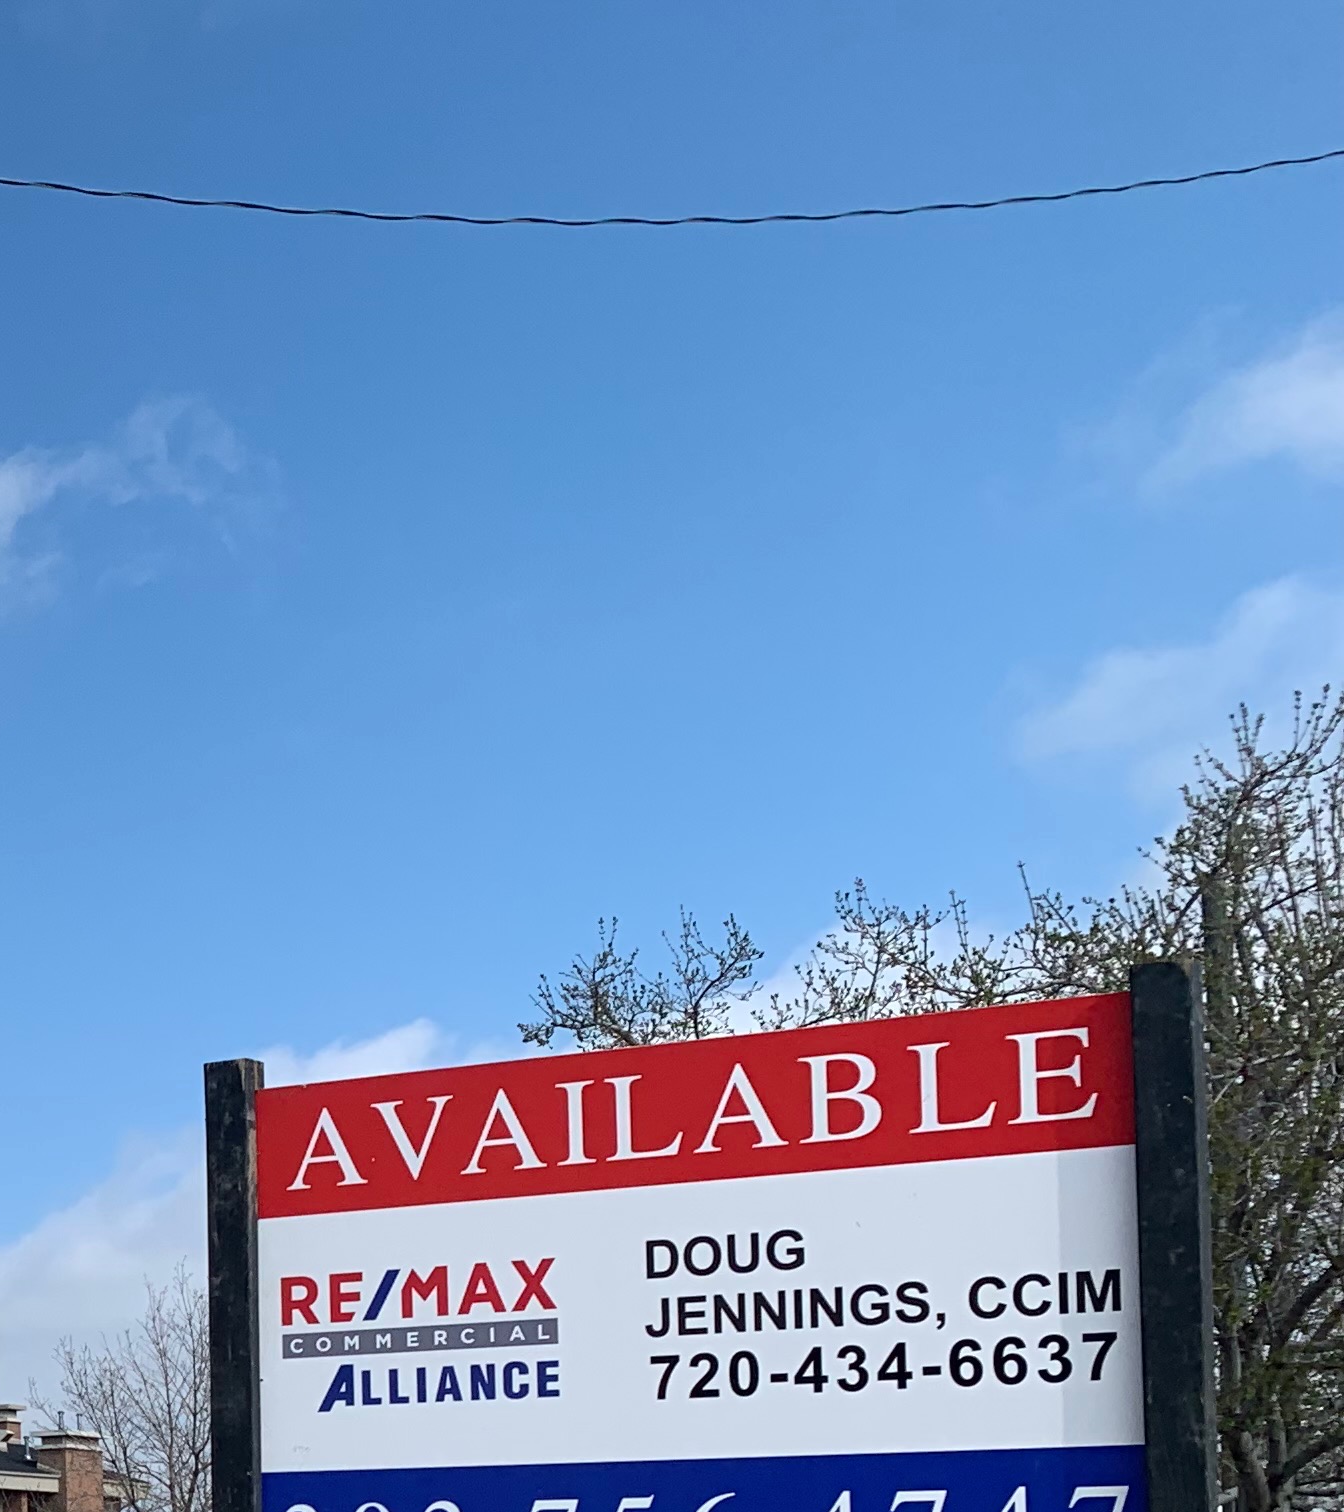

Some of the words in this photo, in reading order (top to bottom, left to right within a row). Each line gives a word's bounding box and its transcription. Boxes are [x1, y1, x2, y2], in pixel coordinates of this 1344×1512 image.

[285, 1026, 1100, 1192] AVAILABLE
[645, 1229, 806, 1280] DOUG
[279, 1257, 558, 1327] RE/MAX
[644, 1280, 947, 1338] JENNINGS,
[968, 1268, 1123, 1320] CCIM
[288, 1323, 551, 1354] COMMERCIAL
[648, 1331, 1119, 1401] 720-434-6637
[317, 1359, 561, 1413] ALLIANCE
